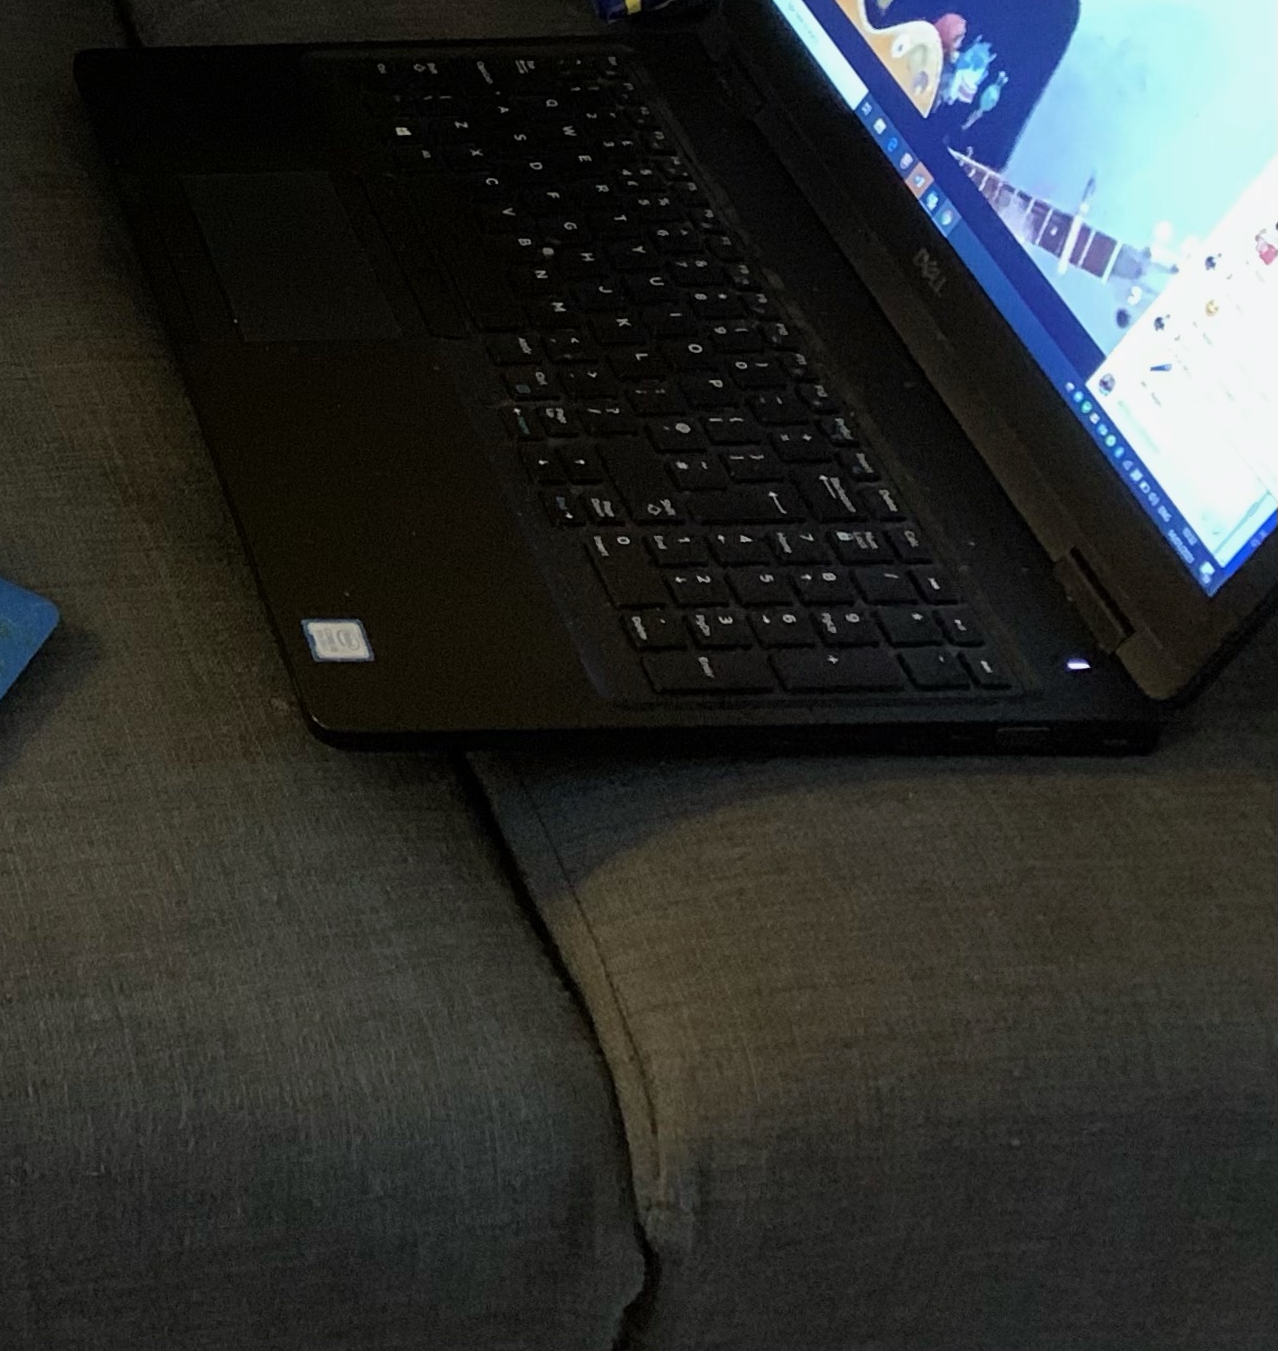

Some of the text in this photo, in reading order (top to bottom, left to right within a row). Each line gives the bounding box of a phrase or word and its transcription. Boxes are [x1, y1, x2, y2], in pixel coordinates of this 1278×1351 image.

[545, 98, 559, 108] Q
[454, 121, 469, 129] Z
[562, 125, 577, 137] W
[513, 133, 527, 141] S
[577, 155, 593, 163] E
[529, 161, 543, 171] D
[485, 177, 499, 186] C
[595, 184, 610, 193] R
[546, 191, 560, 199] F
[502, 207, 516, 216] V
[563, 221, 578, 231] G
[517, 237, 532, 247] B
[632, 245, 646, 254] Y
[580, 252, 595, 262] H
[534, 269, 549, 279] N
[648, 276, 665, 286] U
[598, 285, 613, 294] J
[552, 301, 567, 312] M
[616, 318, 631, 327] K
[687, 343, 703, 354] O
[635, 352, 649, 361] L
[708, 379, 724, 388] P
[696, 575, 711, 584] 2
[759, 574, 774, 583] 5
[821, 572, 837, 582] 8
[718, 616, 734, 625] 3
[782, 613, 797, 624] 6
[845, 612, 860, 623] 9
